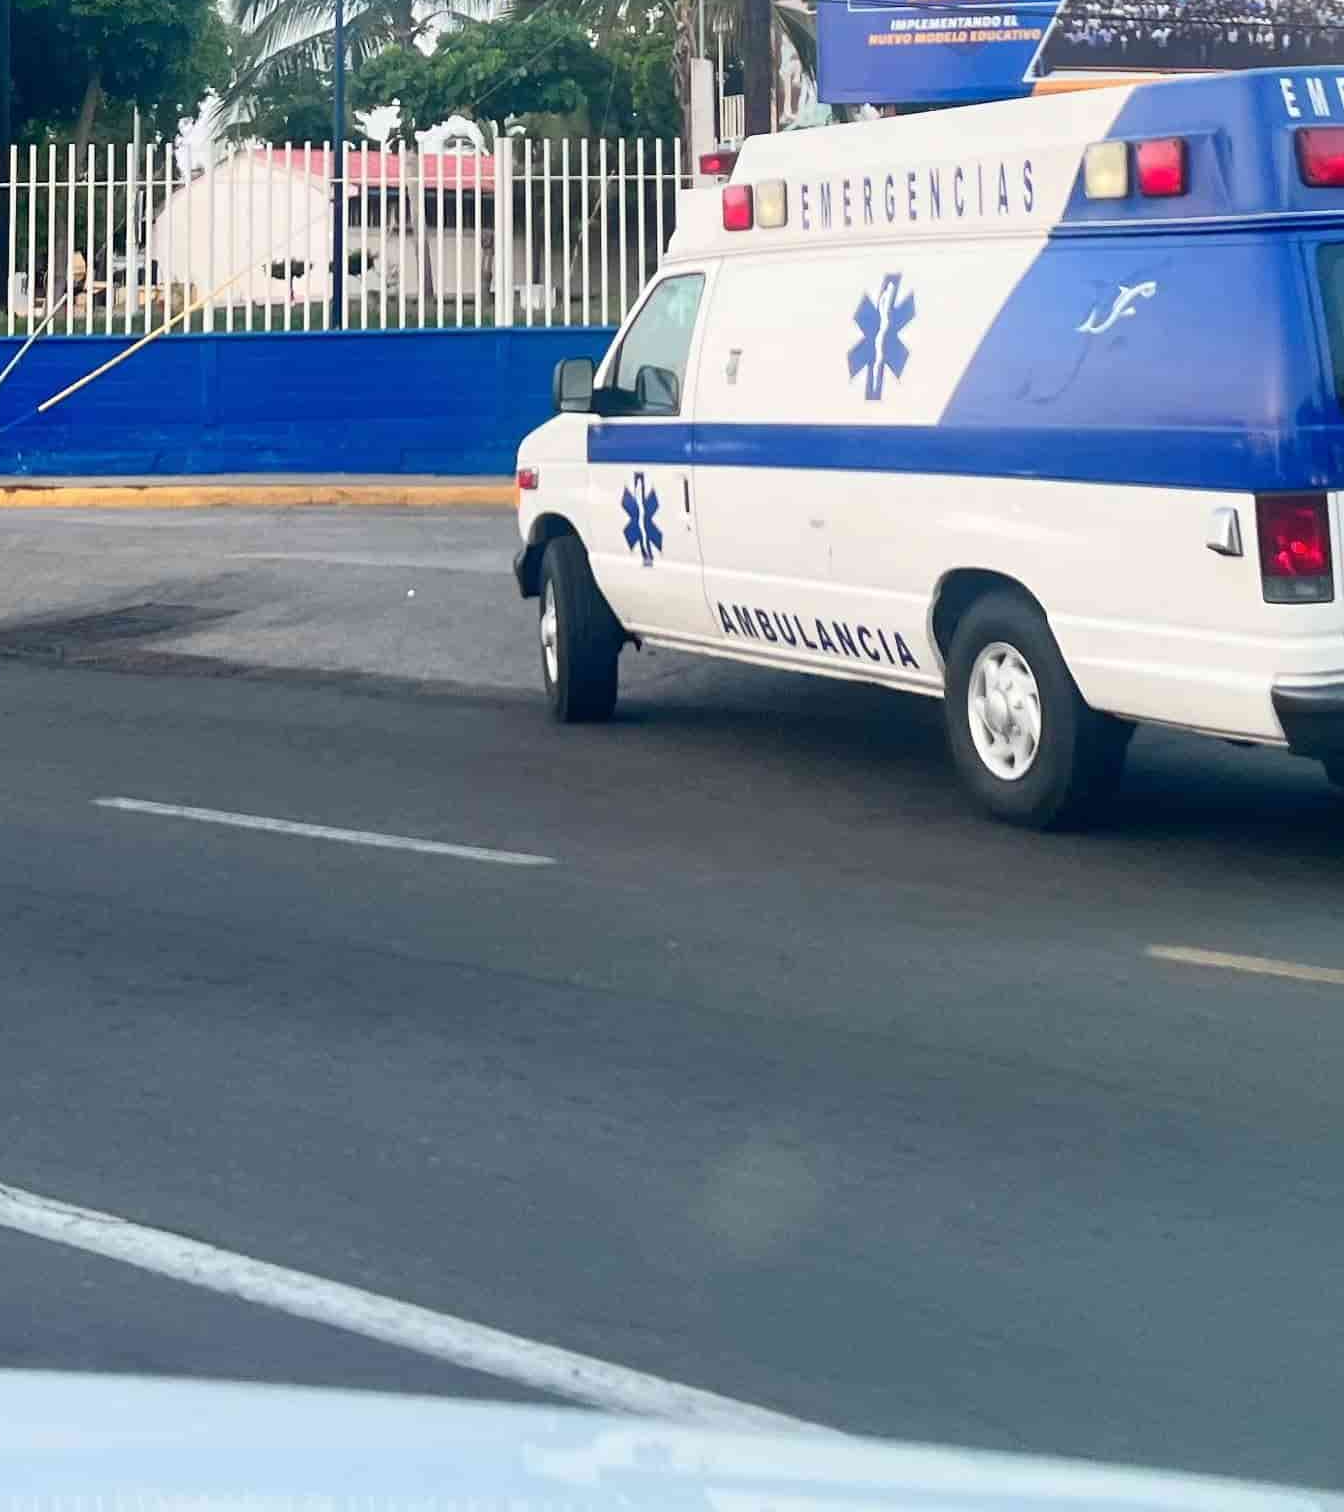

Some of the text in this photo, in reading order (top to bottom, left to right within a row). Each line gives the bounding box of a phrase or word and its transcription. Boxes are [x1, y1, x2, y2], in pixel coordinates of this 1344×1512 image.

[868, 28, 1042, 46] NUEVO MODELO EDUCATIVO
[890, 14, 1019, 31] IMPLEMENTANDO EL
[801, 159, 1033, 230] EMERGENCIAS
[717, 600, 921, 670] AMBULANCIA
